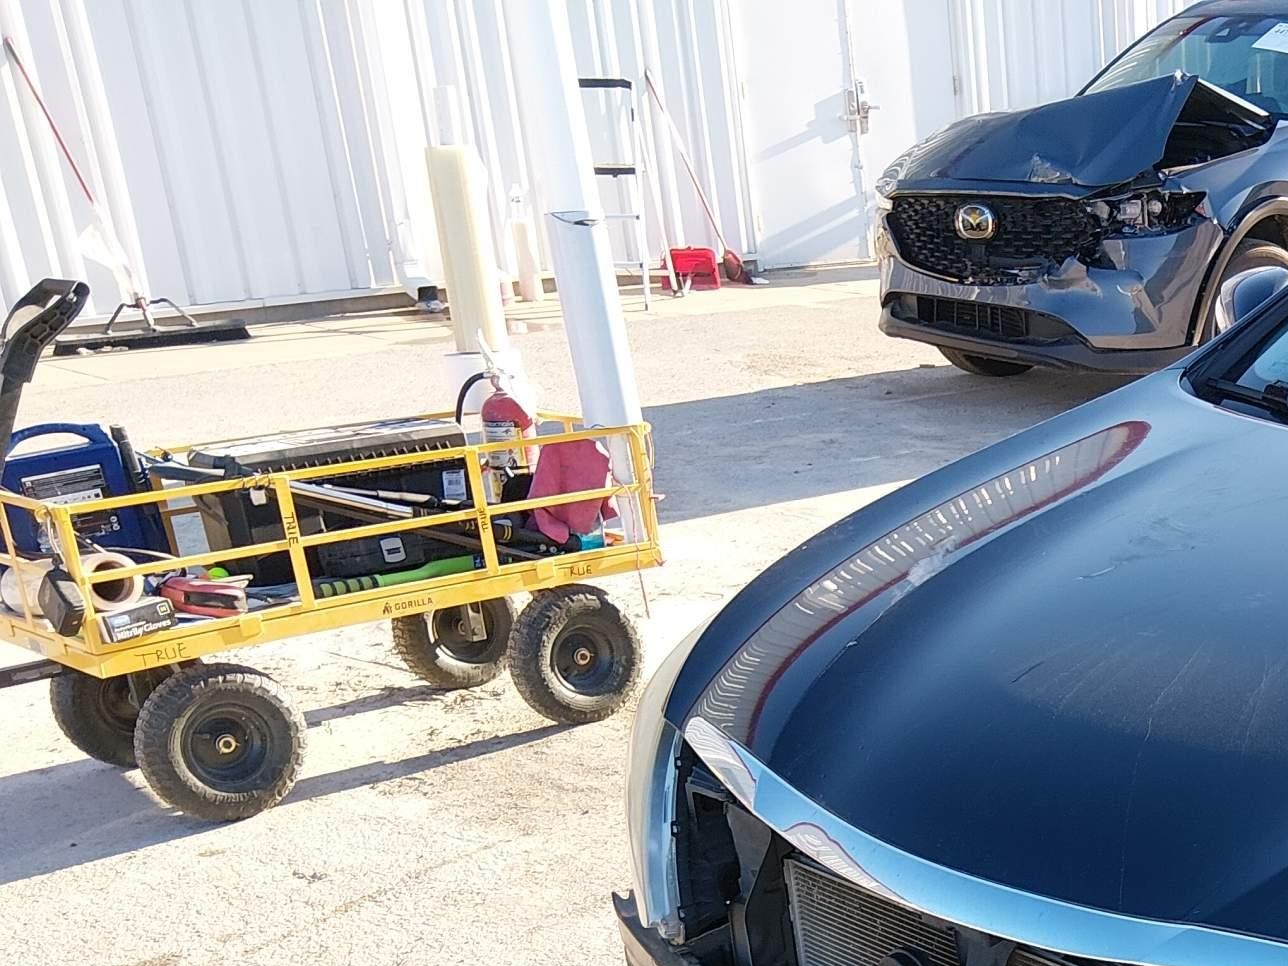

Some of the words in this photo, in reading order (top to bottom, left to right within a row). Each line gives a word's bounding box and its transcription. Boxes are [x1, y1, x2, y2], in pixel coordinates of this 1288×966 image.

[284, 512, 299, 548] TRUE
[394, 597, 433, 611] GORILLA
[134, 642, 191, 667] TRUE
